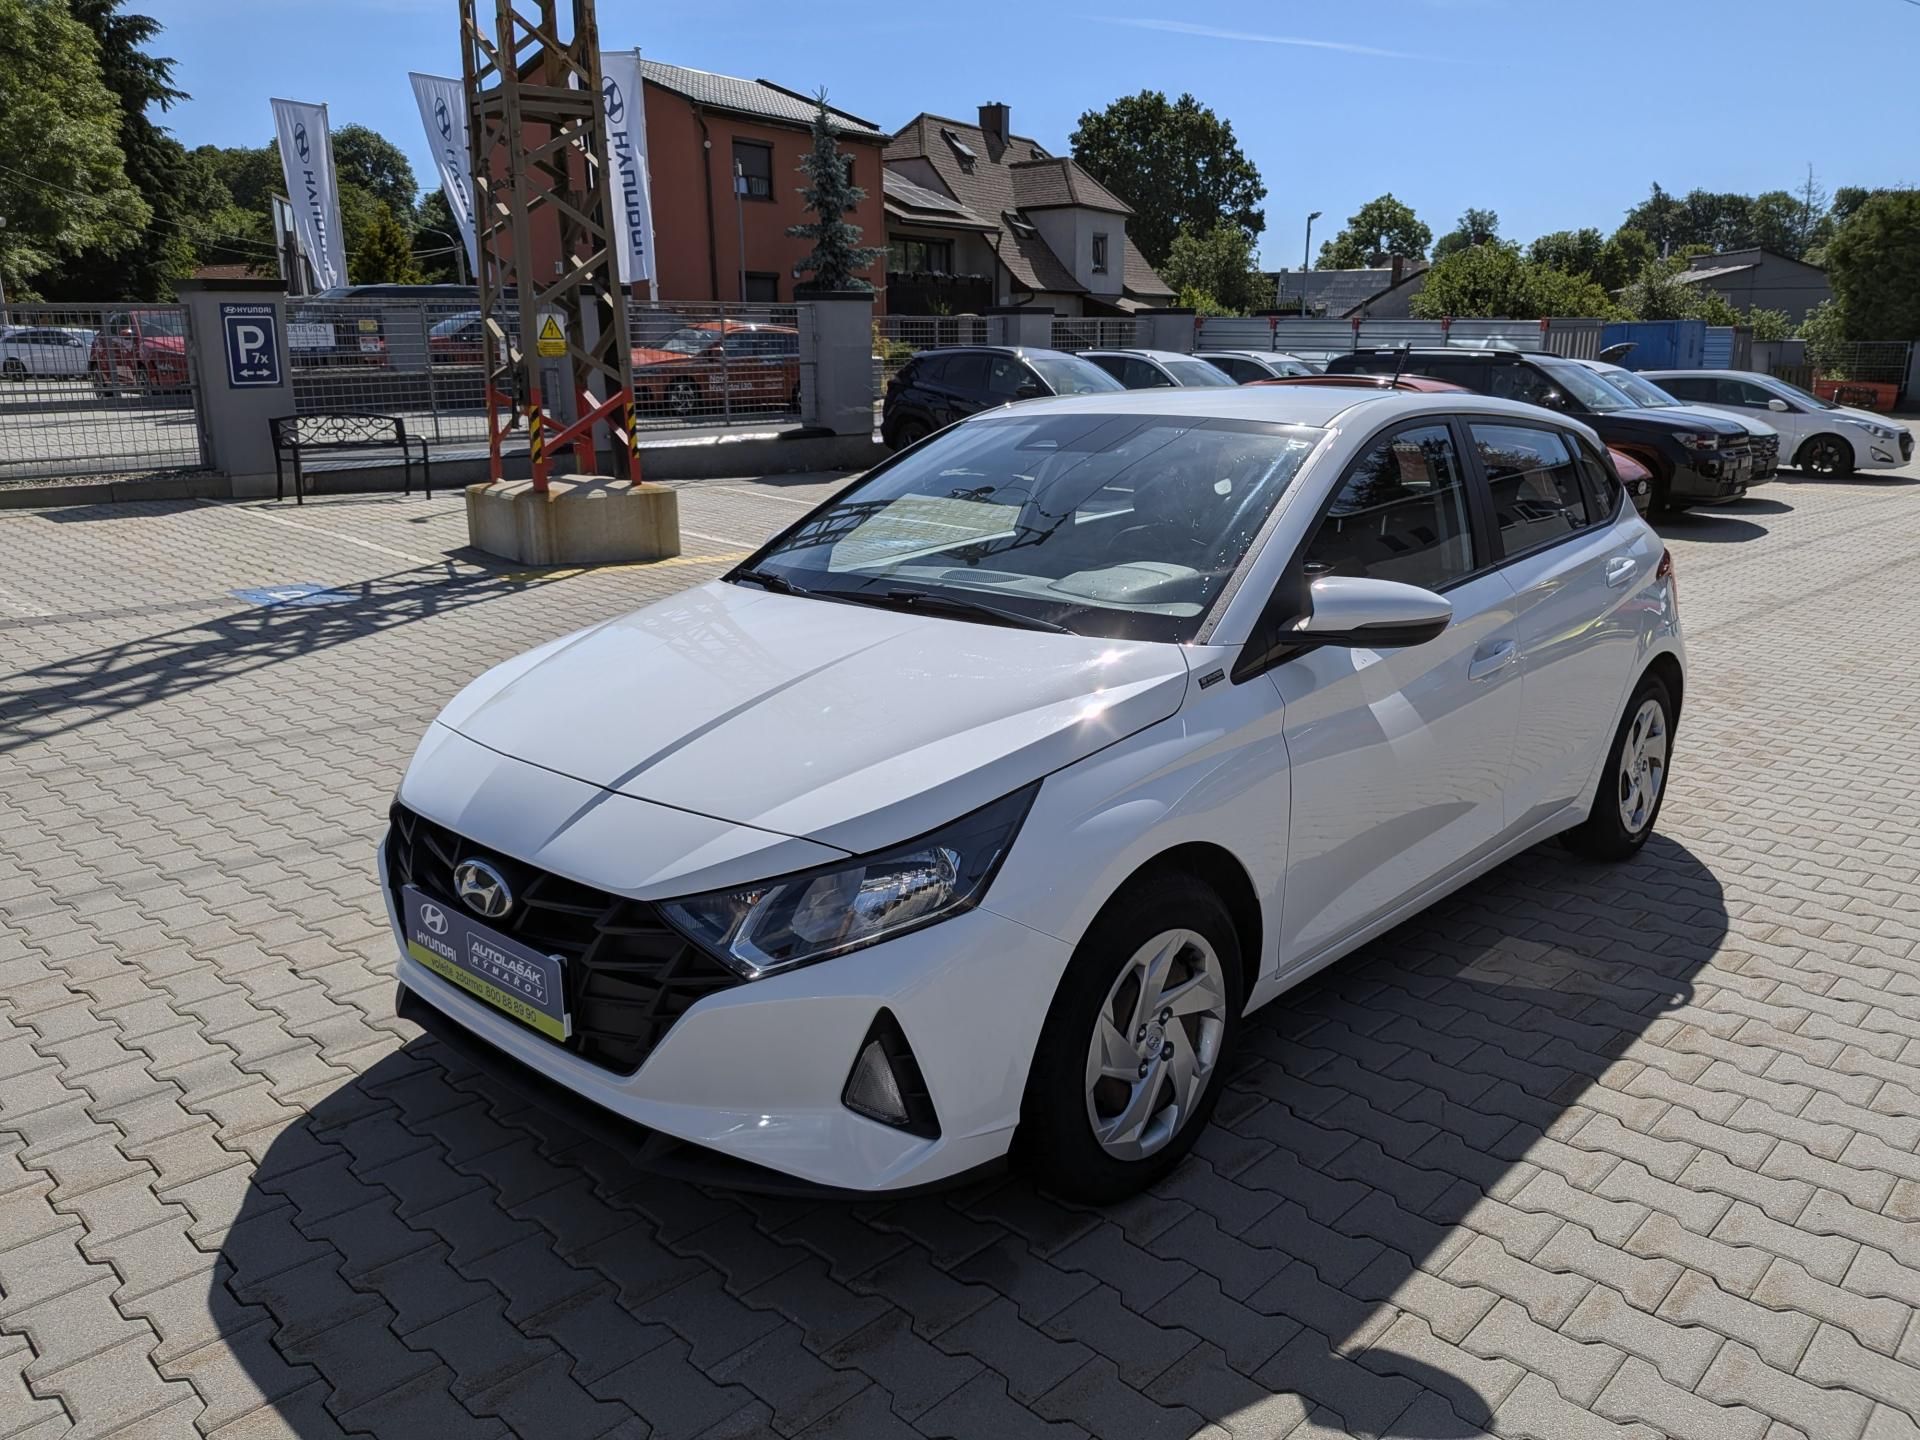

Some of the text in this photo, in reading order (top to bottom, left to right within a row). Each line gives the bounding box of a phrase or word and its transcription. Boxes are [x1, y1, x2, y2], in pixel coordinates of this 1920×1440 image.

[612, 131, 644, 256] HYUNDAI
[236, 306, 272, 314] HYUNDAI
[237, 325, 265, 364] P
[252, 352, 269, 364] 7x
[416, 929, 457, 962] HYUNDAI
[471, 941, 541, 985] AUTOLAŠÁK
[455, 970, 484, 994] zdarma
[486, 985, 501, 1003] 800
